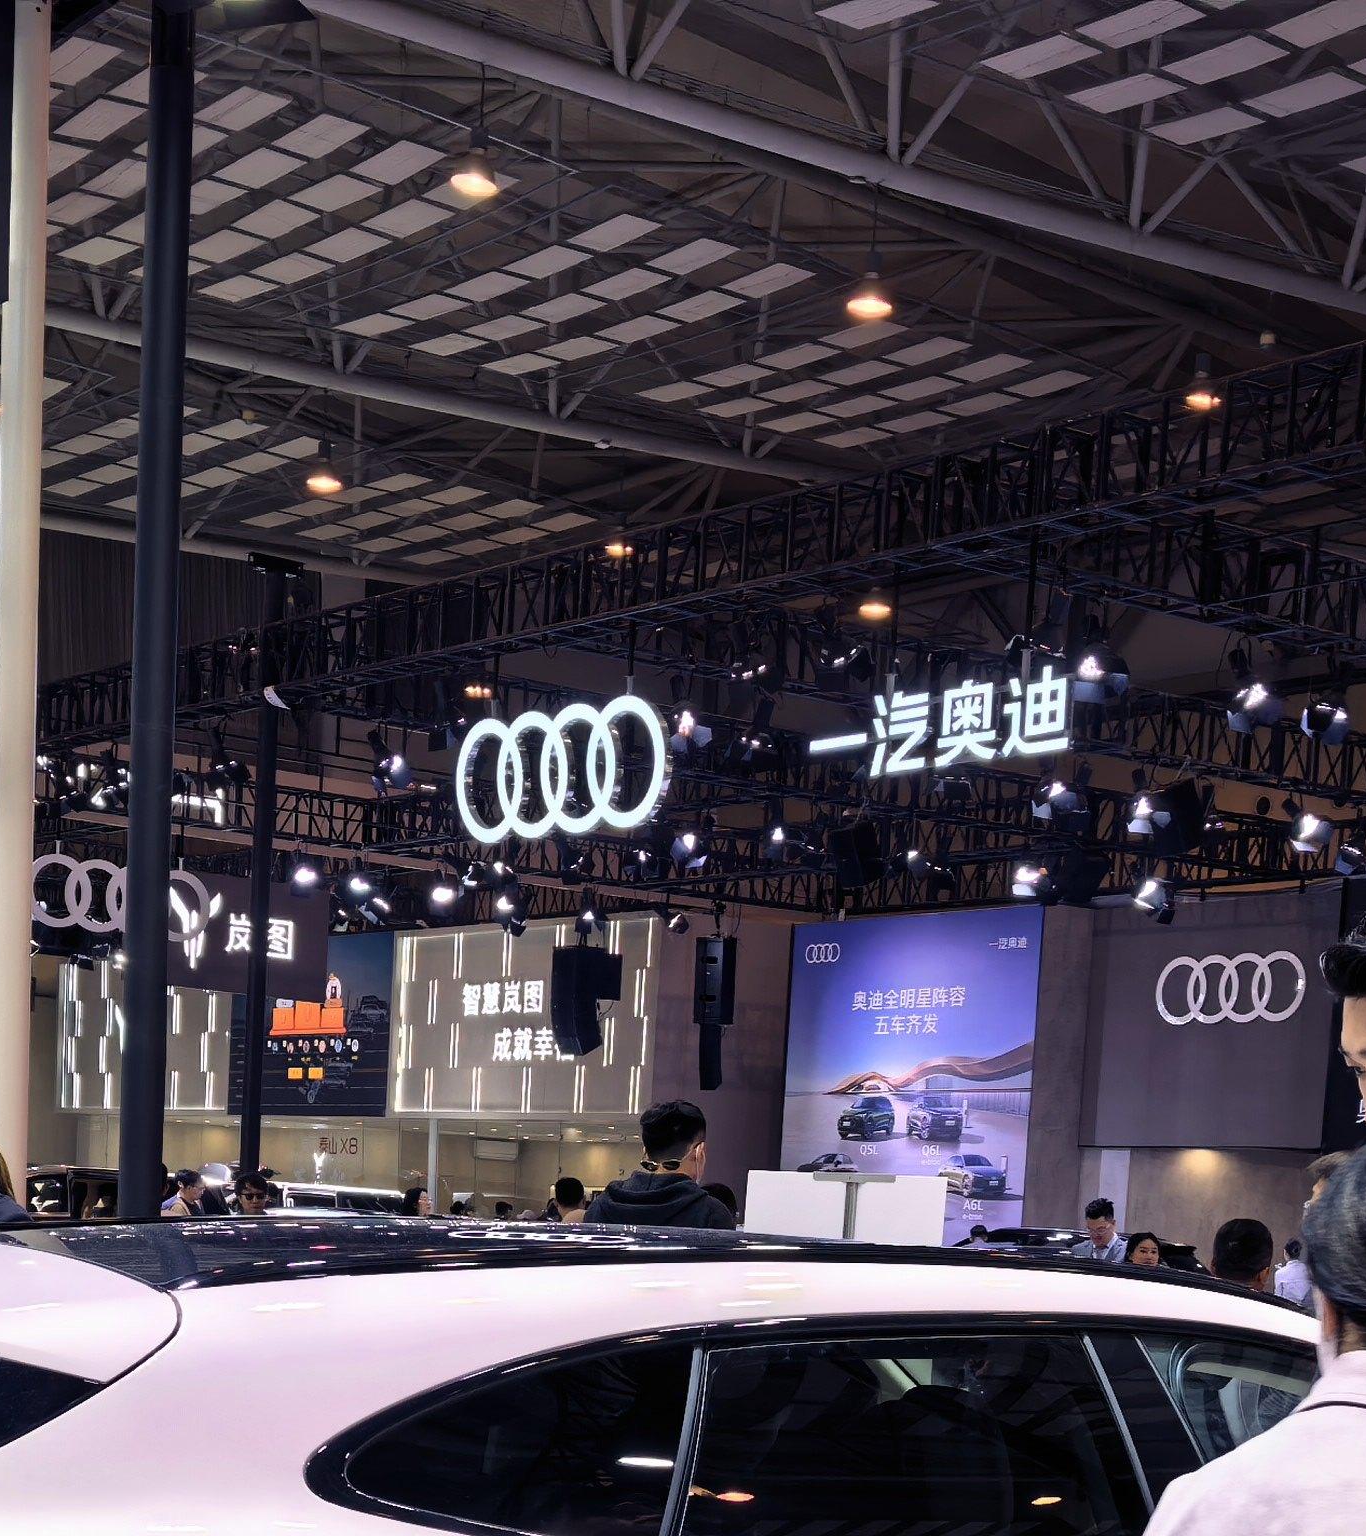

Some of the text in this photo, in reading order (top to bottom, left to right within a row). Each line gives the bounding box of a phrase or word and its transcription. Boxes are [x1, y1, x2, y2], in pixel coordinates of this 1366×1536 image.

[809, 665, 1069, 778] 一汽奥迪
[225, 912, 295, 960] 岚图
[462, 980, 544, 1017] 智慧岚图
[852, 986, 966, 1012] 奥迪全明星阵容
[874, 1014, 939, 1035] 五车齐发
[492, 1026, 575, 1062] 成就幸
[340, 1137, 359, 1155] X8
[859, 1144, 879, 1156] Q5L
[921, 1144, 942, 1157] Q6L
[963, 1199, 984, 1211] A6L
